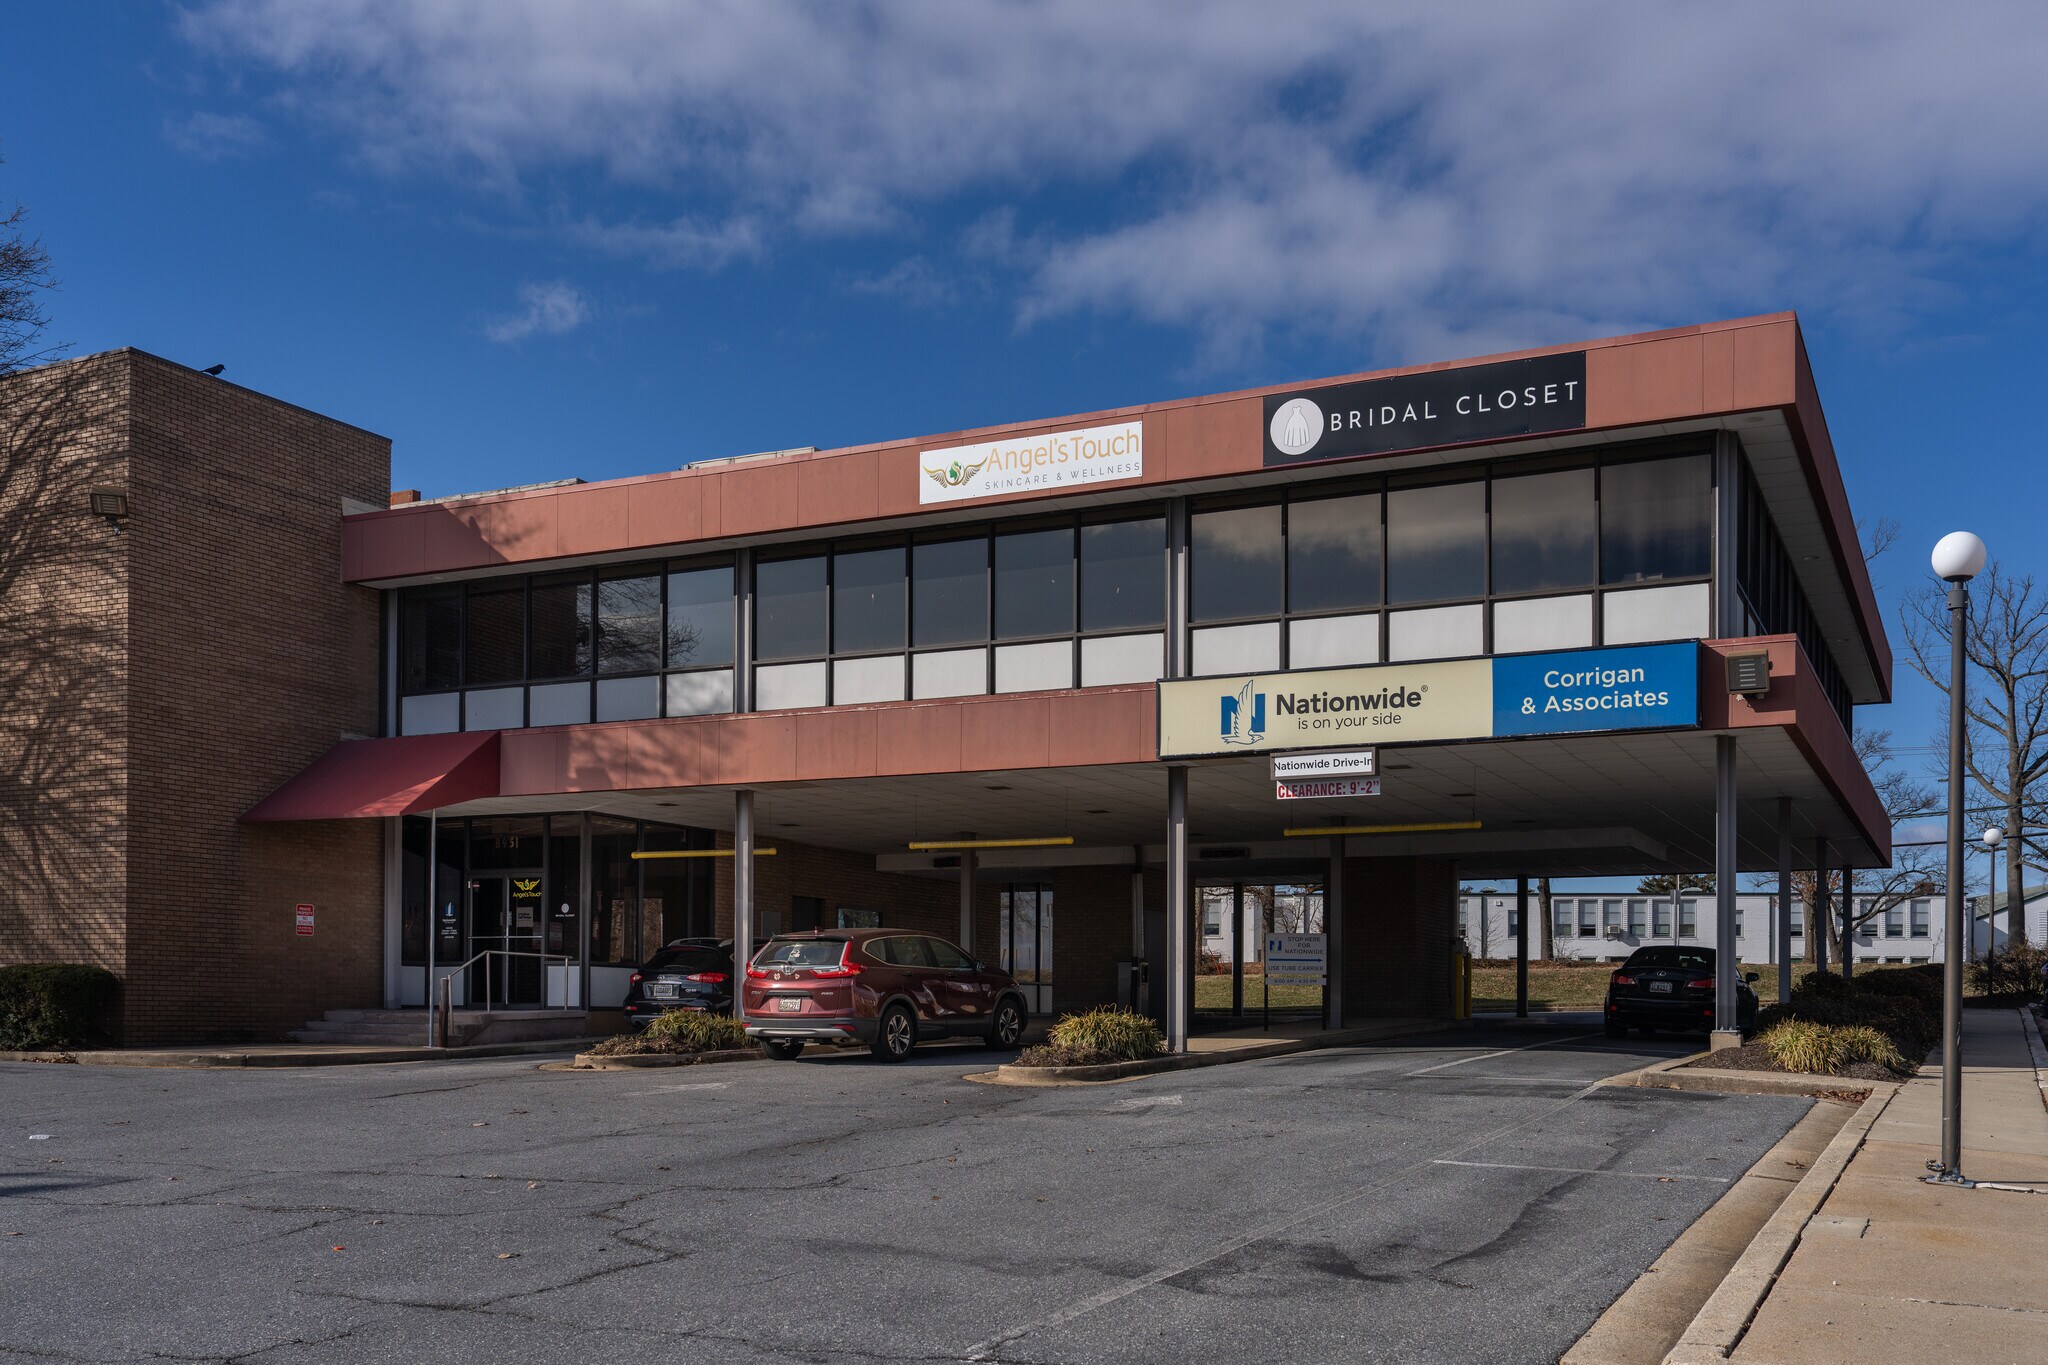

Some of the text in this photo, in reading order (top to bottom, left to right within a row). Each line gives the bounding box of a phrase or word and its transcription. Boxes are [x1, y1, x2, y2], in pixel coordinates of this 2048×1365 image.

[1330, 381, 1578, 432] BRIDAL CLOSET
[985, 462, 1140, 490] SKINCARE & WELLNESS
[1544, 667, 1645, 688] Corrigan
[1521, 690, 1669, 715] & Associates
[1298, 712, 1402, 730] is on your side
[1275, 759, 1330, 771] Nationwide
[1277, 782, 1346, 798] CLEARANCE:
